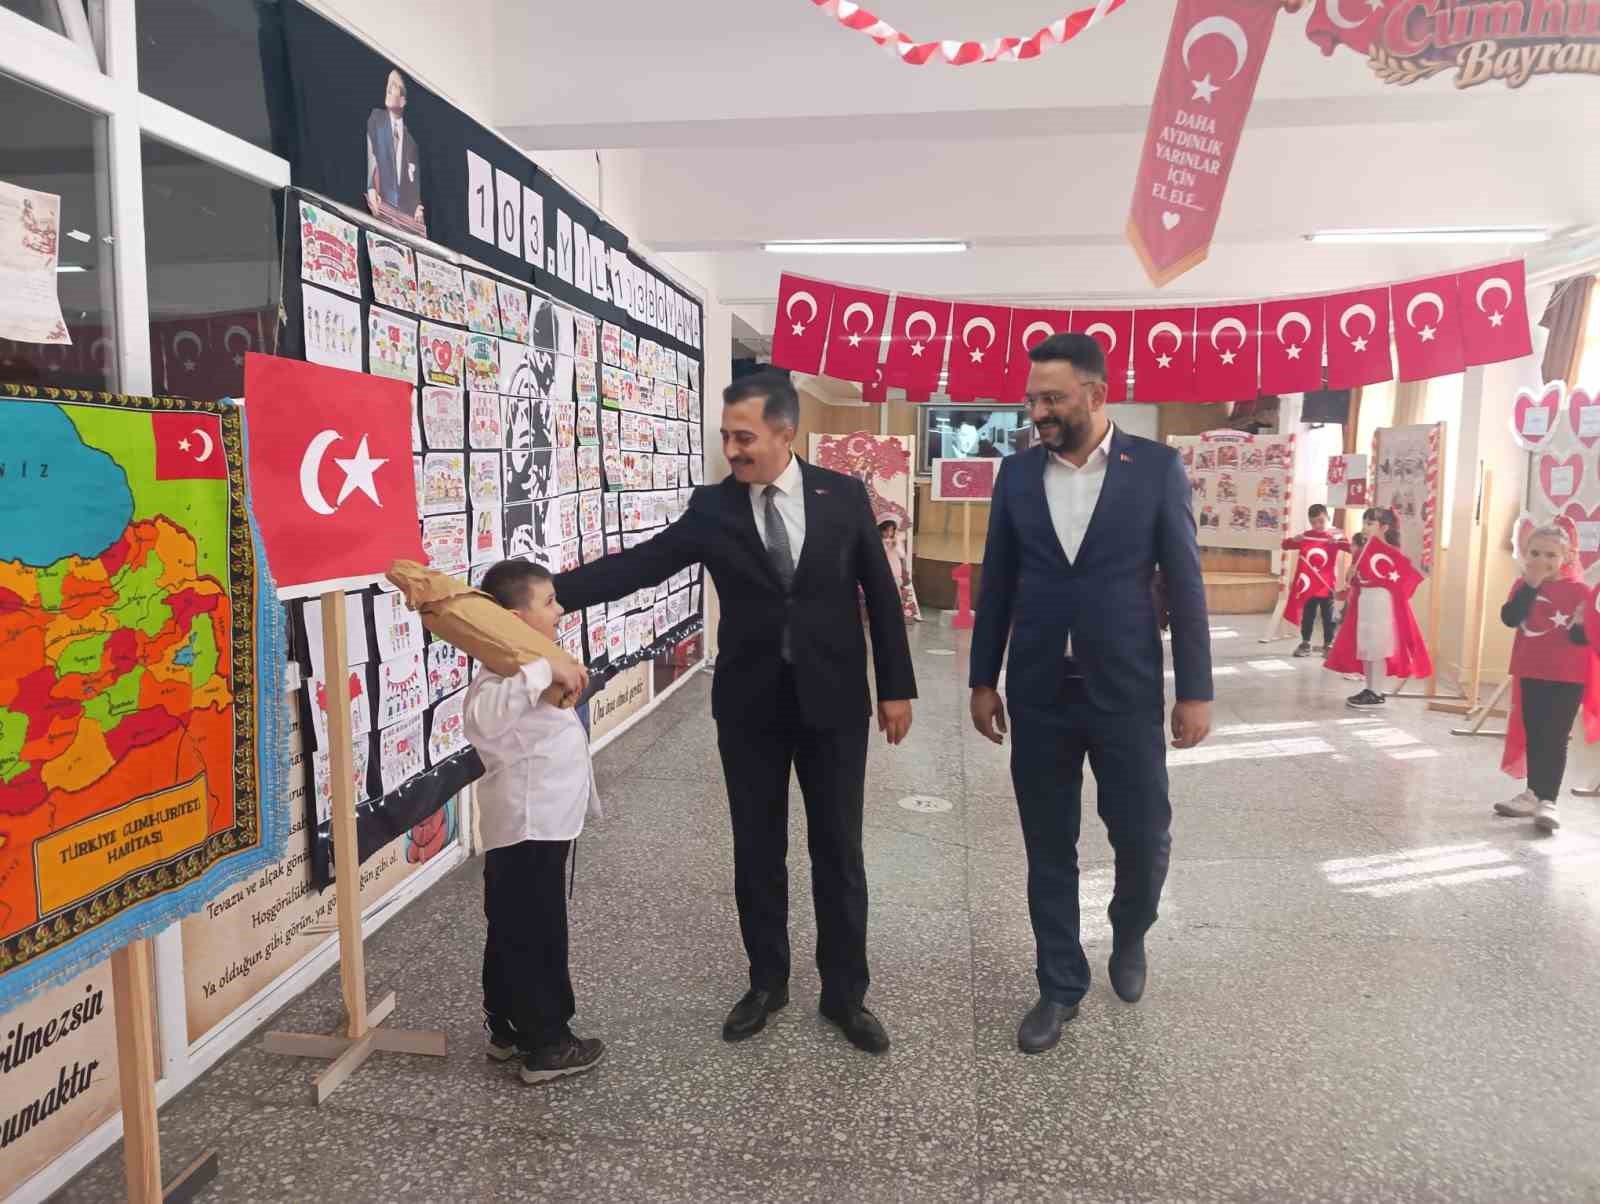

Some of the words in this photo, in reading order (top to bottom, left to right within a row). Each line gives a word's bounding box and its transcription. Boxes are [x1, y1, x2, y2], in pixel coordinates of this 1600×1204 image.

[1175, 110, 1216, 134] DAHA
[1156, 142, 1221, 175] YARINLAR
[1160, 127, 1223, 156] AYDINLIK
[1168, 164, 1196, 187] İÇİN
[59, 831, 117, 865] TÜRKİYE
[106, 830, 164, 864] HARİTASI
[206, 890, 244, 920] Tevazu
[245, 880, 257, 897] ve
[259, 861, 285, 889] alçak
[202, 981, 217, 1000] Ya
[219, 950, 263, 988] olduğun
[265, 930, 284, 960] gibi
[0, 983, 104, 1075] ilmezsin
[0, 1059, 99, 1149] umaktır
